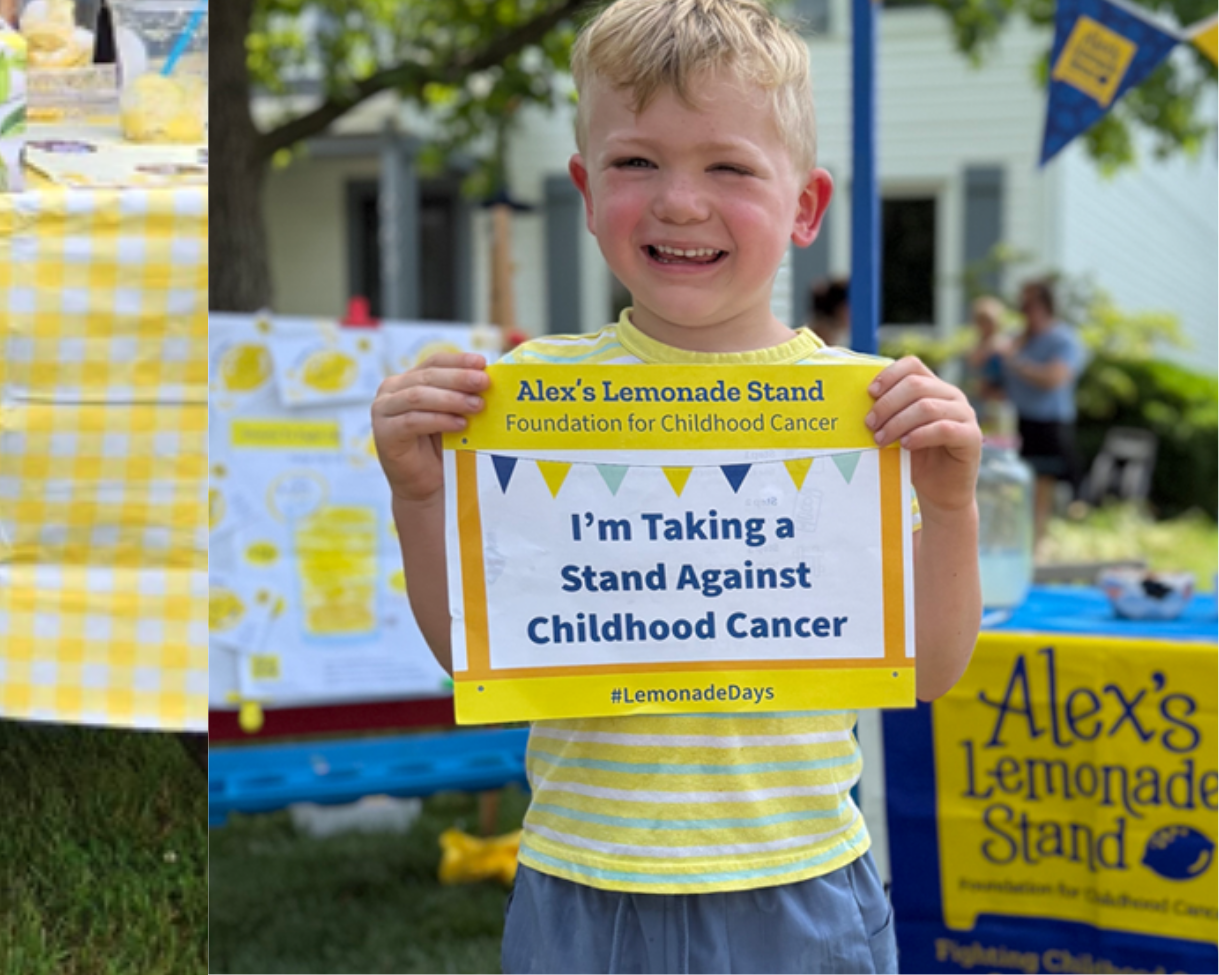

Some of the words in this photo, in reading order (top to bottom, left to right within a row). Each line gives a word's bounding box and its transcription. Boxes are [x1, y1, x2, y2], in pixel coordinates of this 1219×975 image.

[516, 379, 596, 403] Alex's
[602, 380, 742, 402] Lemonade
[747, 380, 825, 401] Stand
[505, 413, 624, 433] Foundation
[627, 413, 657, 433] for
[661, 413, 765, 433] Childhood
[770, 414, 839, 432] Cancer
[571, 511, 632, 541] I'm
[641, 510, 766, 547] Taking
[775, 517, 795, 538] a
[560, 563, 666, 593] Stand
[677, 561, 812, 596] Against
[527, 611, 716, 644] Childhood
[726, 612, 848, 639] Cancer
[610, 683, 775, 704] #LemonadeDays
[977, 646, 1202, 754] Alex's
[981, 803, 1130, 872] Stand
